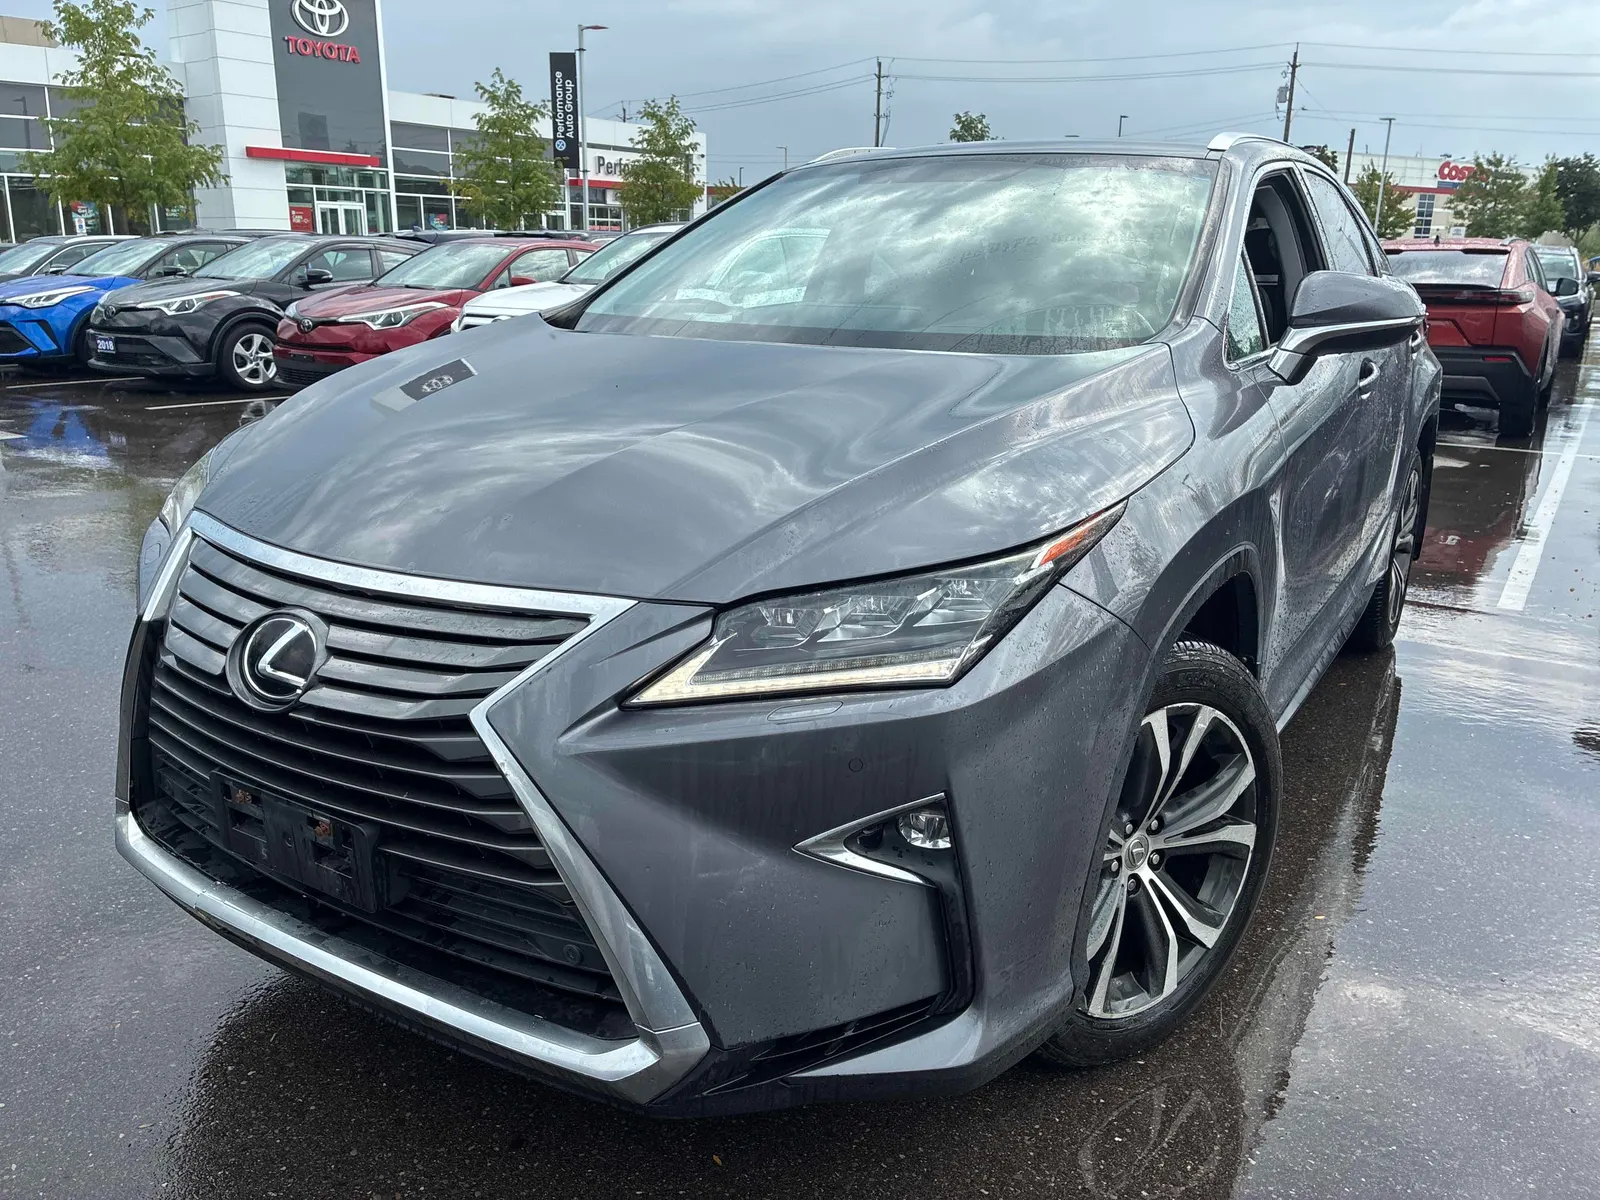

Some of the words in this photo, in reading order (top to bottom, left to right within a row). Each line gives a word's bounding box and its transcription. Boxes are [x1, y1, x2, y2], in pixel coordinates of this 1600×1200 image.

[284, 36, 360, 63] TOYOTA
[555, 71, 565, 138] Performance
[565, 79, 575, 112] Group
[565, 114, 574, 138] Auto
[1438, 160, 1490, 182] COST
[97, 340, 114, 350] 2018
